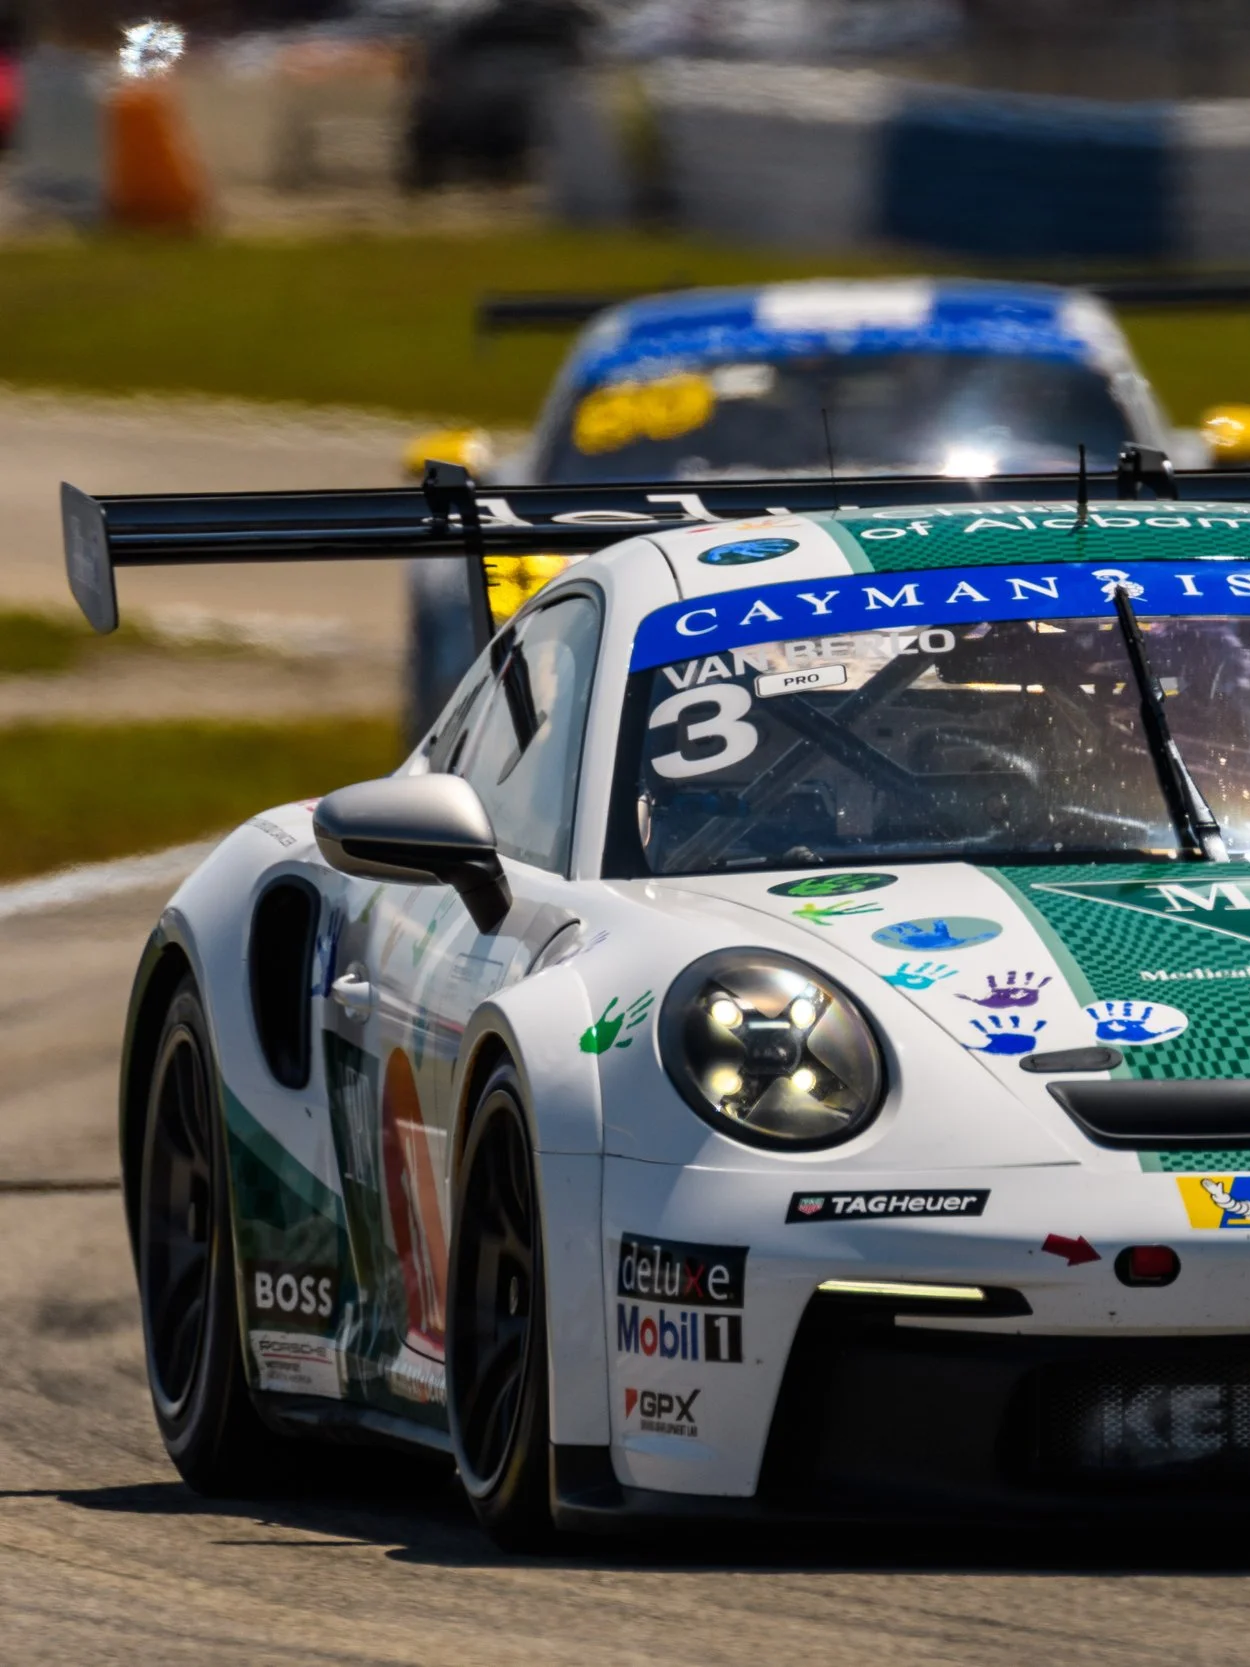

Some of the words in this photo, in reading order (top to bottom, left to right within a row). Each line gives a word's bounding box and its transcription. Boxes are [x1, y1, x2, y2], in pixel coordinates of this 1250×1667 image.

[861, 521, 933, 539] of
[675, 576, 1059, 637] CAYMAN
[663, 648, 768, 690] VAN
[785, 629, 956, 660] BERLO
[784, 672, 820, 687] PRO
[649, 683, 758, 778] 3
[255, 1271, 333, 1317] BOSS
[622, 1241, 730, 1301] deluxe
[617, 1303, 698, 1361] Mobil
[640, 1389, 701, 1423] GPX
